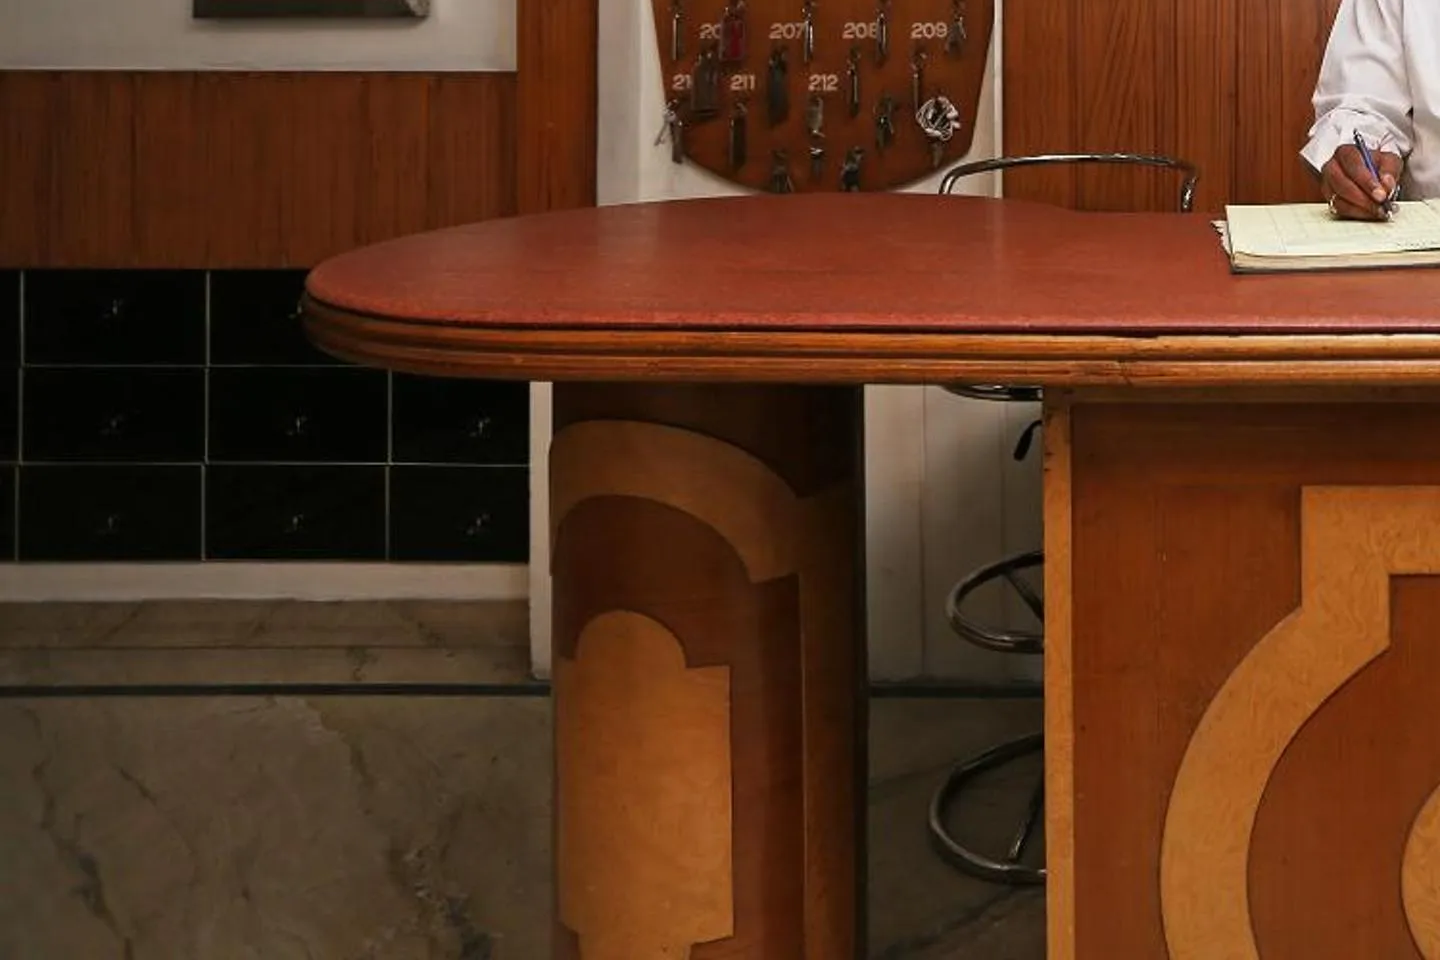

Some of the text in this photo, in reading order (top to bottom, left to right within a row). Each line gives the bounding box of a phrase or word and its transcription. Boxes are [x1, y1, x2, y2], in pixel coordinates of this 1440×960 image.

[700, 22, 948, 40] 20 207 208 209
[672, 74, 838, 91] 21 211 212
